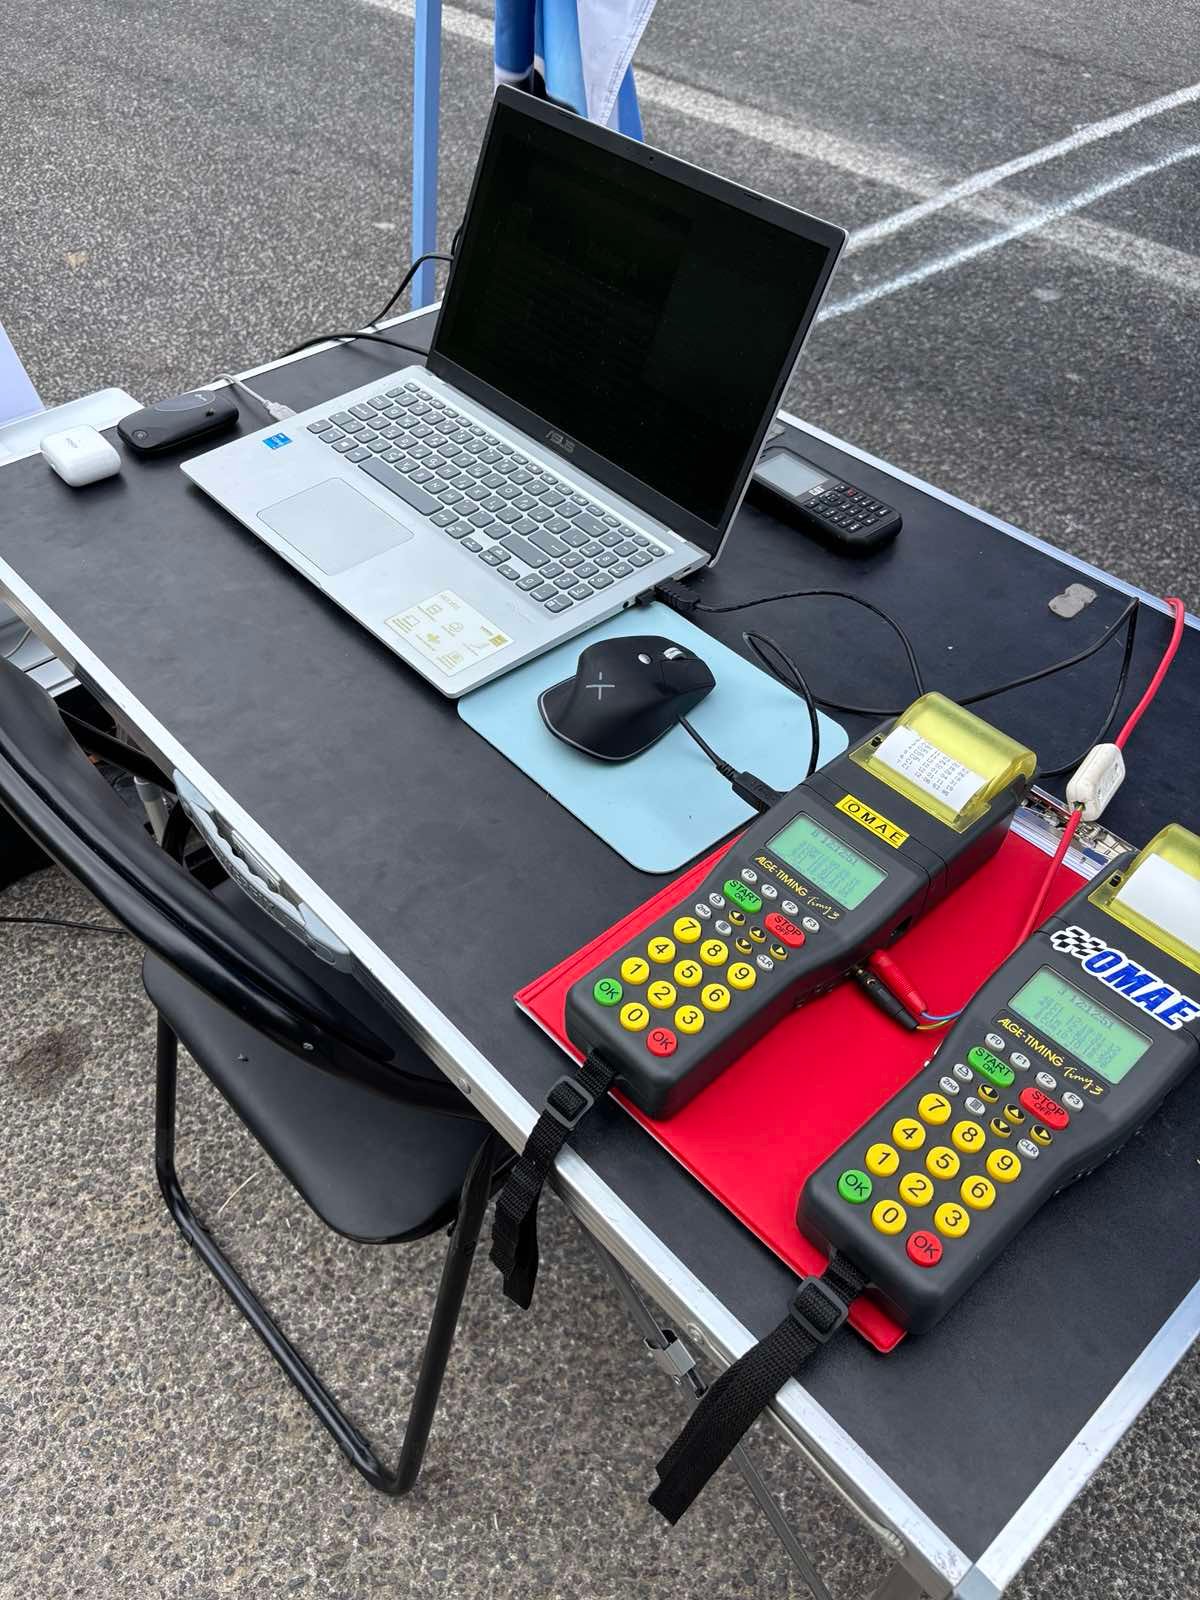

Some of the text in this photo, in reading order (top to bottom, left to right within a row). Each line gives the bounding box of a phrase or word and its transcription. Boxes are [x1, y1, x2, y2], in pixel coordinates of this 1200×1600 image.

[847, 802, 904, 843] OMAE
[744, 869, 755, 879] F0
[729, 880, 761, 904] START
[755, 856, 808, 896] ALGE-TIMING
[827, 911, 840, 920] 3
[734, 892, 745, 903] ON
[697, 904, 710, 915] 2nd
[785, 902, 796, 911] F2
[680, 920, 696, 933] 7
[774, 915, 802, 936] STOP
[806, 918, 817, 928] F3
[655, 942, 670, 955] 4
[707, 944, 722, 956] 8
[629, 963, 642, 975] 1
[681, 964, 698, 979] 5
[735, 967, 750, 980] 9
[599, 981, 619, 1000] OK
[653, 986, 671, 1001] 2
[708, 988, 725, 1002] 6
[1084, 951, 1199, 1026] OMAE
[682, 1010, 698, 1025] 3
[652, 1031, 673, 1050] OK
[990, 1035, 1002, 1045] F0
[975, 1047, 1013, 1077] START
[998, 1018, 1104, 1095] ALGE-TIMING Timy 3
[1015, 1054, 1027, 1065] F1
[982, 1063, 996, 1074] ON
[943, 1078, 958, 1091] 2nd
[1041, 1074, 1053, 1084] F2
[928, 1098, 945, 1112] 7
[1032, 1090, 1065, 1116] STOP
[1068, 1094, 1080, 1105] F3
[1033, 1102, 1050, 1116] OFF
[901, 1126, 918, 1140] 4
[961, 1127, 978, 1142] 8
[1020, 1139, 1038, 1154] CLR
[877, 1151, 891, 1165] 1
[935, 1153, 954, 1169] 5
[996, 1155, 1014, 1171] 9
[844, 1174, 869, 1196] OK
[908, 1179, 927, 1198] 2
[970, 1182, 989, 1198] 6
[944, 1210, 962, 1227] 3
[914, 1235, 939, 1258] OK
